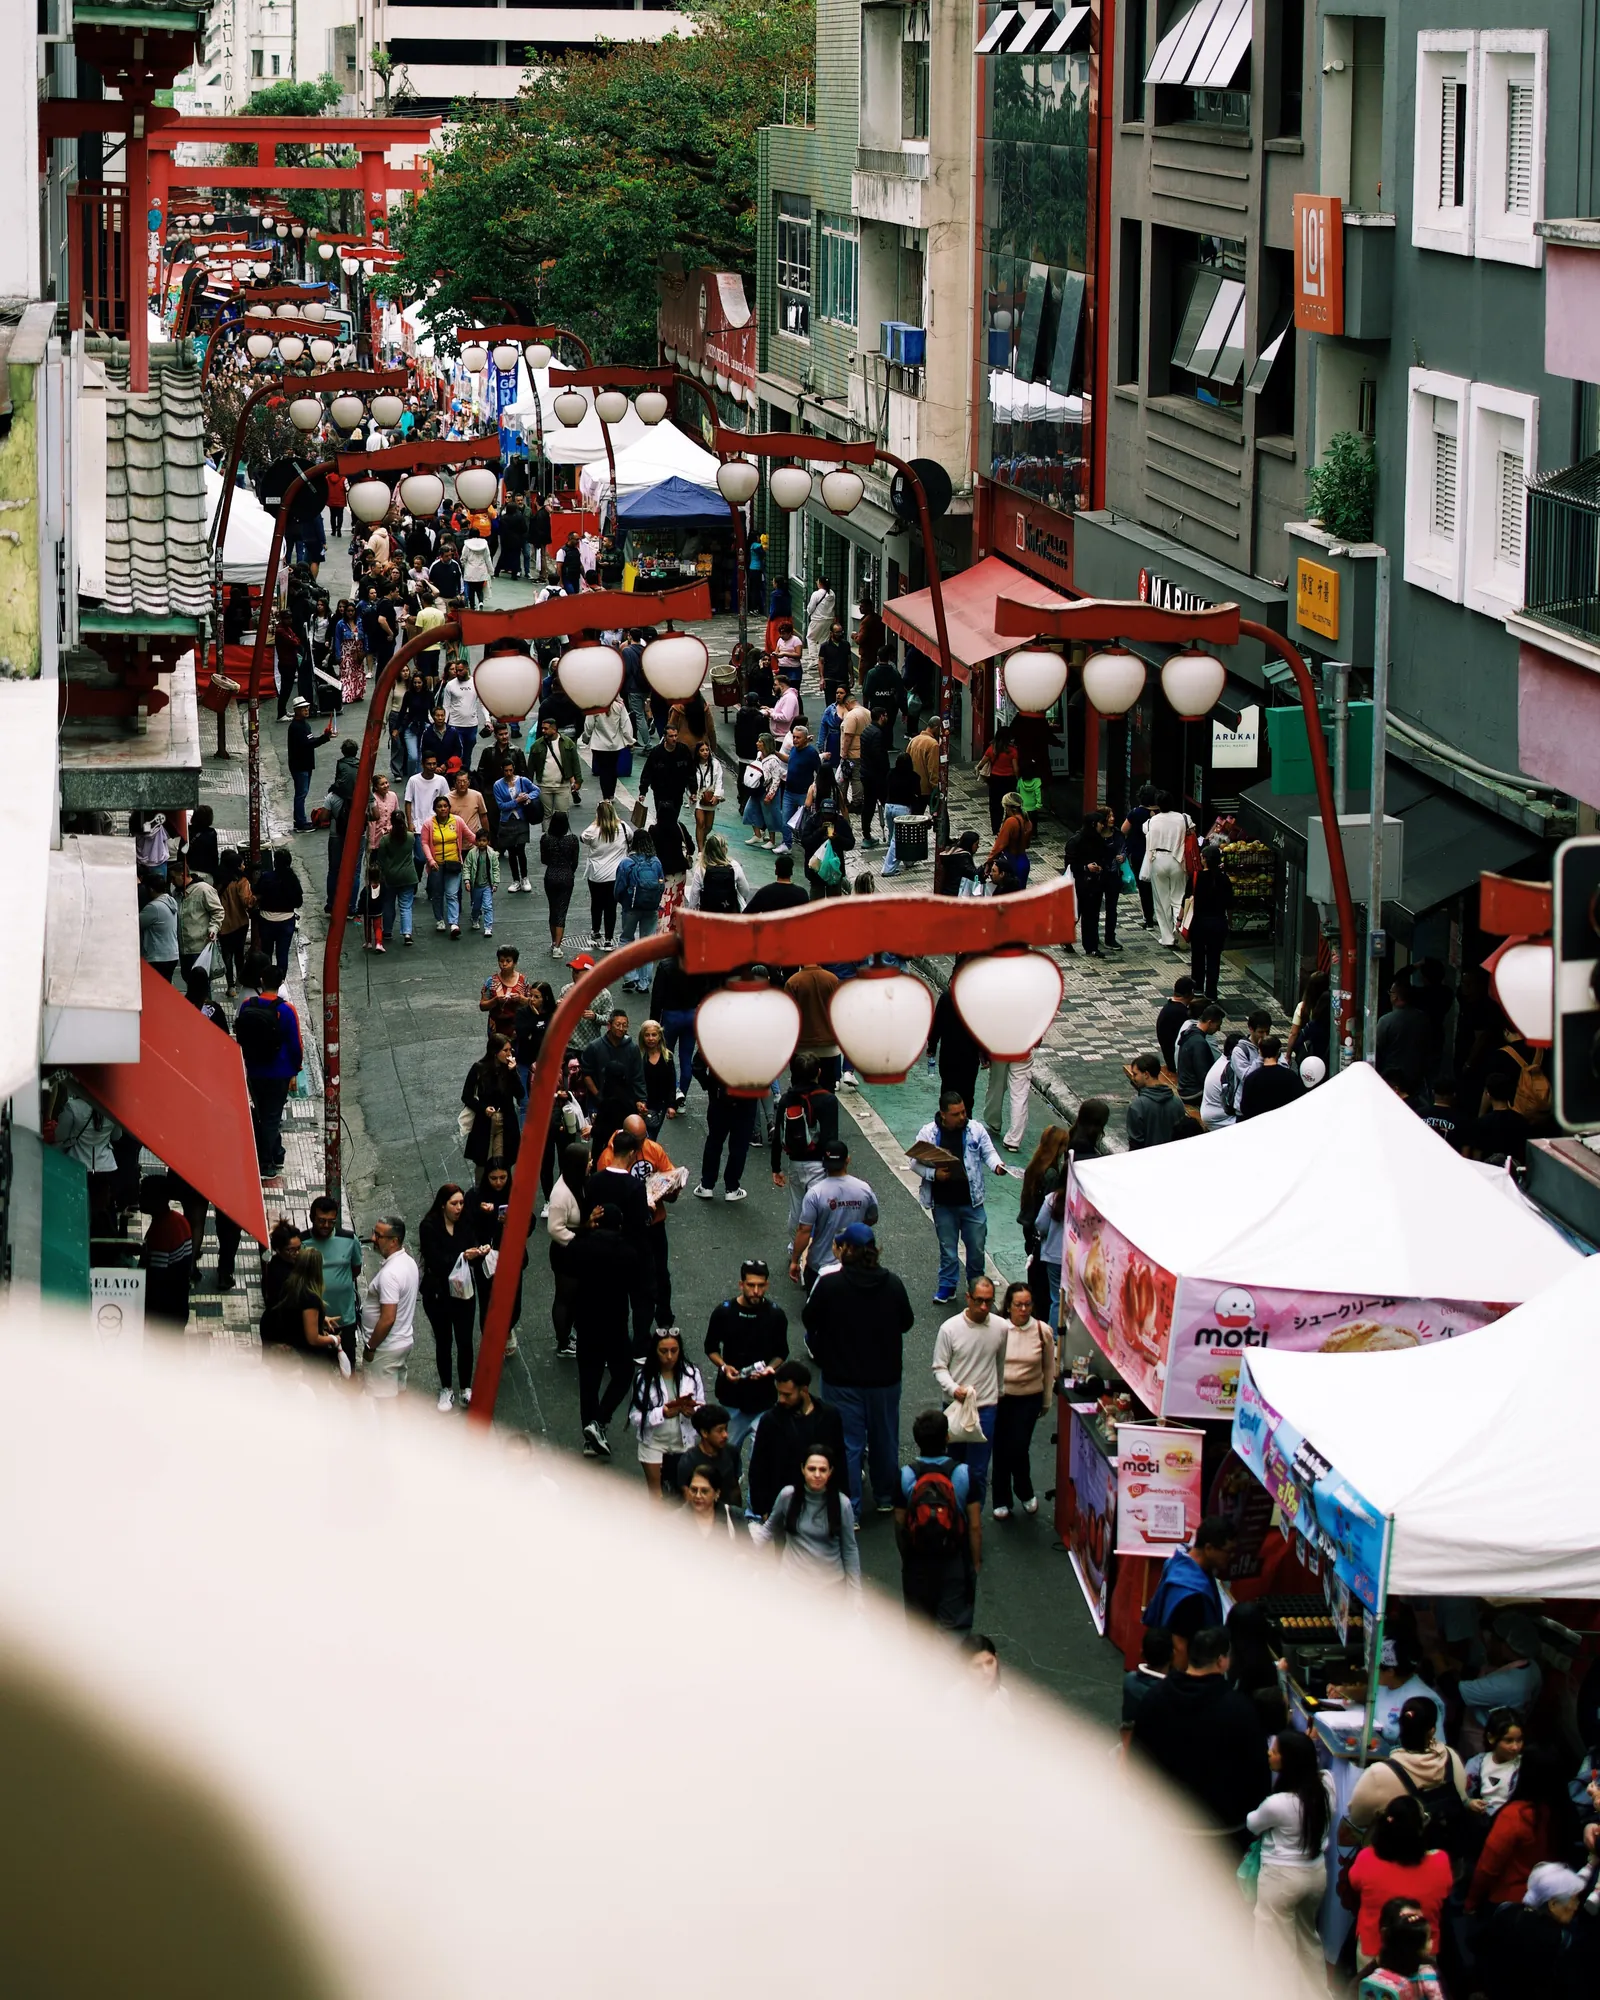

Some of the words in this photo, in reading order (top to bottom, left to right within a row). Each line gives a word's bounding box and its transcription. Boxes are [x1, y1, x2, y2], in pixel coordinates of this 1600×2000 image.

[1151, 575, 1213, 611] MARUK
[1194, 1324, 1270, 1348] moti
[1122, 1460, 1160, 1474] moti
